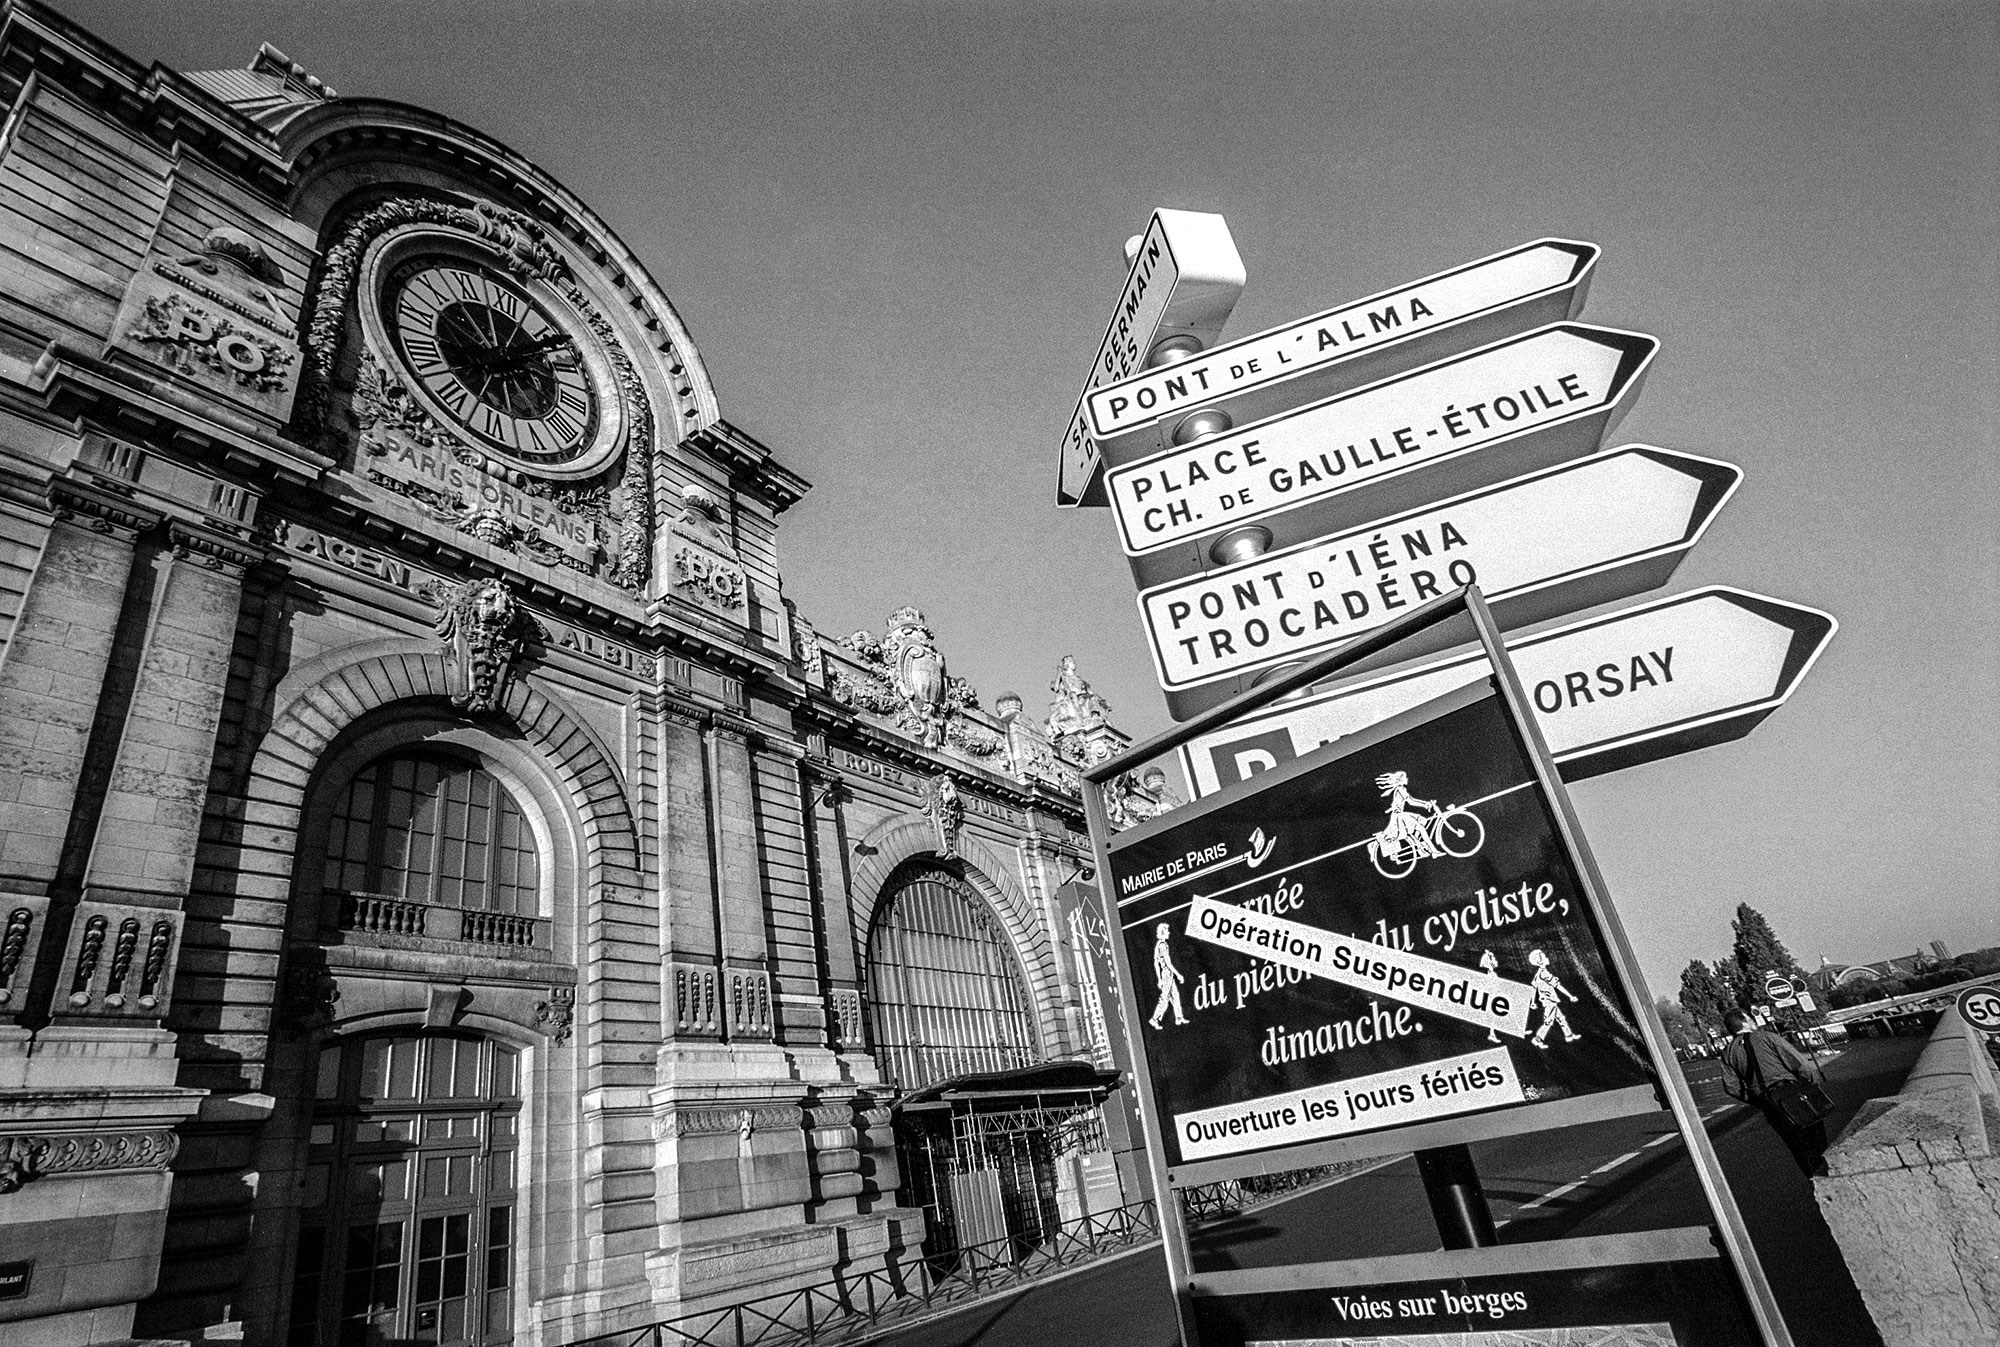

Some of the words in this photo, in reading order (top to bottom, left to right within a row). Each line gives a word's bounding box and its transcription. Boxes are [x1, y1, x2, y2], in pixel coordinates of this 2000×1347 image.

[1105, 238, 1161, 374] GERMAIN
[1109, 367, 1210, 420] PONT
[1230, 357, 1262, 380] DE
[1131, 439, 1268, 502] PLACE
[1144, 499, 1203, 533] CH.
[1220, 487, 1254, 511] DE
[1269, 373, 1589, 493] GAULLE-ÉTOILE
[295, 532, 411, 589] AGEN
[1168, 571, 1285, 630] PONT
[1179, 558, 1477, 666] TROCADÉRO
[559, 627, 634, 671] ALBI
[1533, 646, 1675, 714] ORSAY
[843, 750, 905, 787] RODEZ
[968, 795, 1015, 824] TULLE
[1423, 880, 1569, 952] cycliste,
[1193, 972, 1228, 1011] du
[1233, 958, 1322, 1010] piéto
[1200, 908, 1322, 963] Opération
[1332, 945, 1512, 1018] Suspendue
[1261, 1004, 1424, 1067] dimanche.
[1968, 998, 2000, 1021] 50
[1185, 1105, 1297, 1144] Ouverture
[1302, 1096, 1339, 1121] les
[1344, 1083, 1415, 1123] jours
[1420, 1060, 1505, 1098] fériés
[1332, 1294, 1394, 1321] Voies
[1398, 1294, 1437, 1318] sur
[1441, 1288, 1528, 1319] berges
